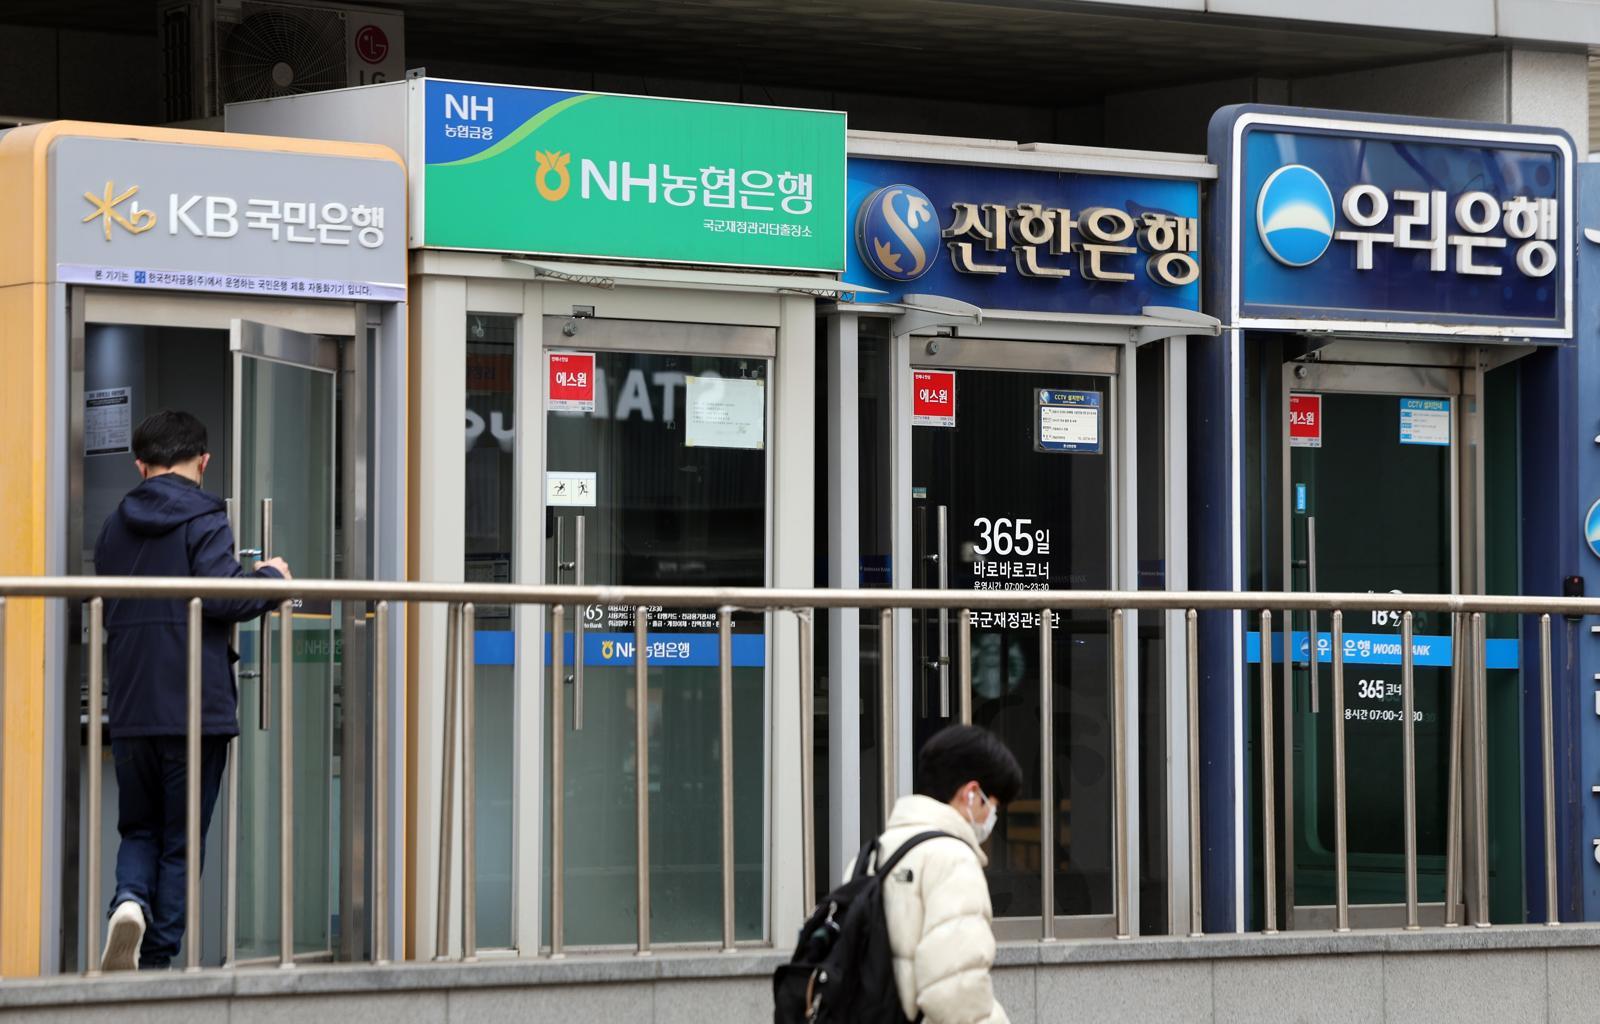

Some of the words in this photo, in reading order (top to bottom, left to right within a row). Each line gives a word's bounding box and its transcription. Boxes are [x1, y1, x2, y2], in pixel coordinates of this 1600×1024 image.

[445, 93, 493, 121] NH
[445, 124, 493, 140] 농협금융
[581, 158, 813, 215] NH농협은행
[245, 198, 384, 249] 국민은행
[703, 219, 812, 238] 국군재정관리단출장소
[1335, 184, 1558, 278] 우리은행
[943, 203, 1200, 287] 신한은행
[105, 271, 129, 282] 기기는
[225, 277, 256, 289] 운영하는
[258, 279, 288, 291] 국민은행
[556, 371, 588, 388] 에스원
[920, 388, 948, 404] 에스원
[973, 517, 1050, 556] 365일
[973, 560, 1050, 580] 바로바로코너
[583, 603, 604, 622] 65
[1317, 638, 1371, 658] 우은행
[1412, 645, 1431, 656] ANK
[1358, 680, 1385, 699] 365
[1344, 708, 1368, 720] 용시간
